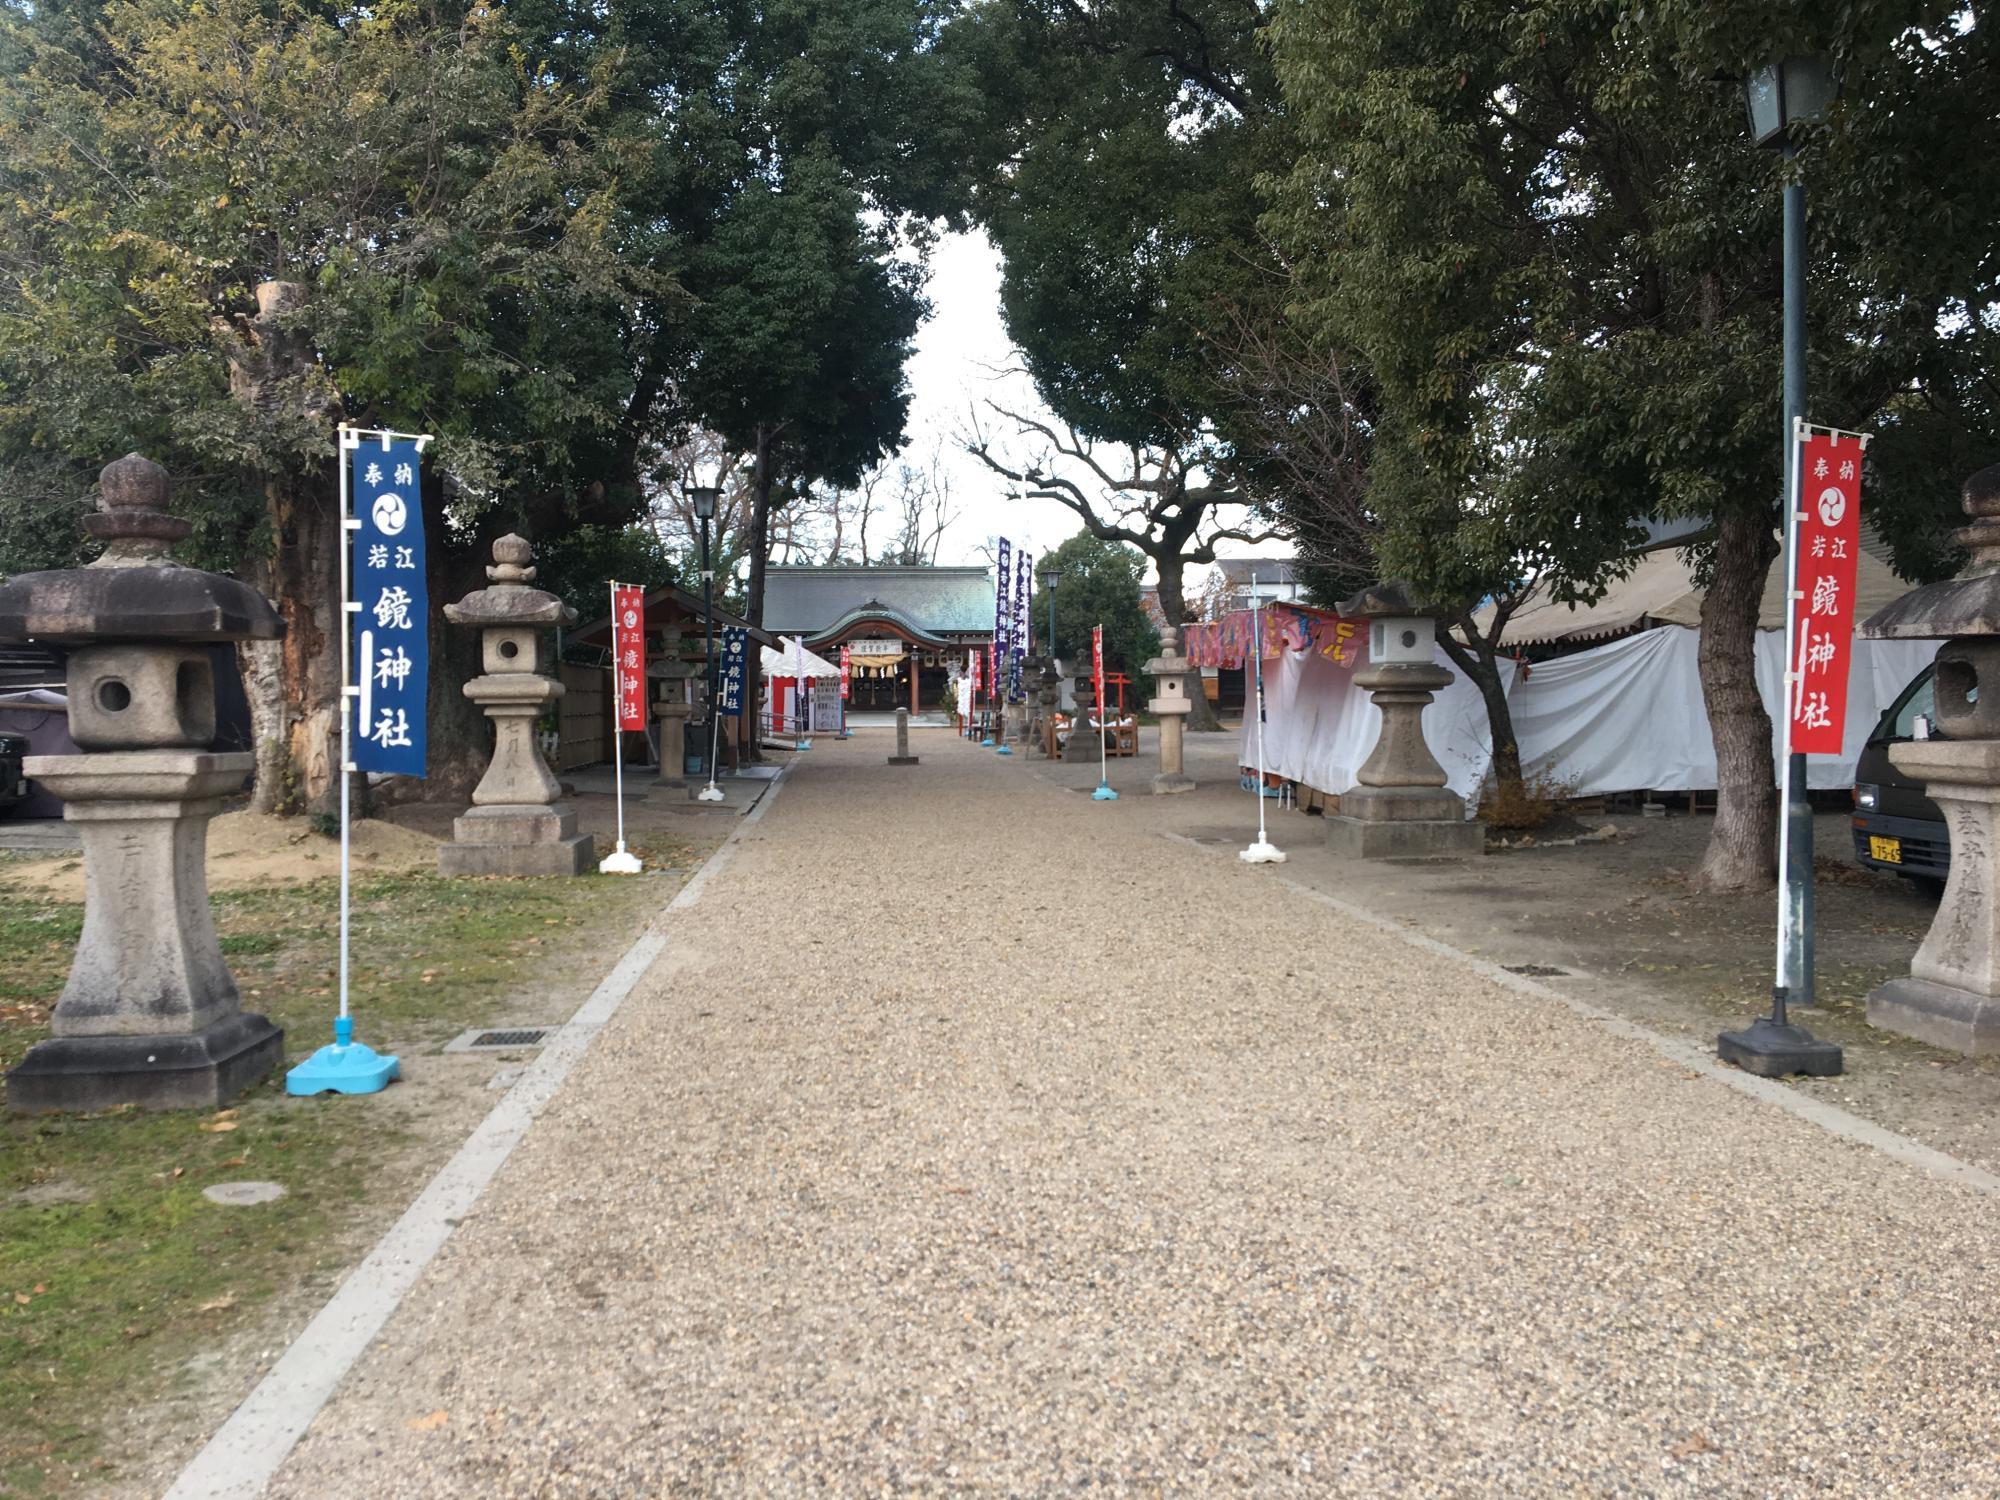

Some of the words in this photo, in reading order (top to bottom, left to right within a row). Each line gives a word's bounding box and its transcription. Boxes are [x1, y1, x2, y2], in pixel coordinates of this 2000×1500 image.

[363, 463, 413, 487] 奉納
[1812, 457, 1855, 484] 奉納
[367, 543, 416, 571] 若江
[1811, 534, 1848, 560] 若江
[371, 586, 414, 750] 鏡神社
[1801, 574, 1842, 731] 鏡神社
[623, 649, 639, 721] 鏡神社
[726, 665, 741, 710] 鏡神社
